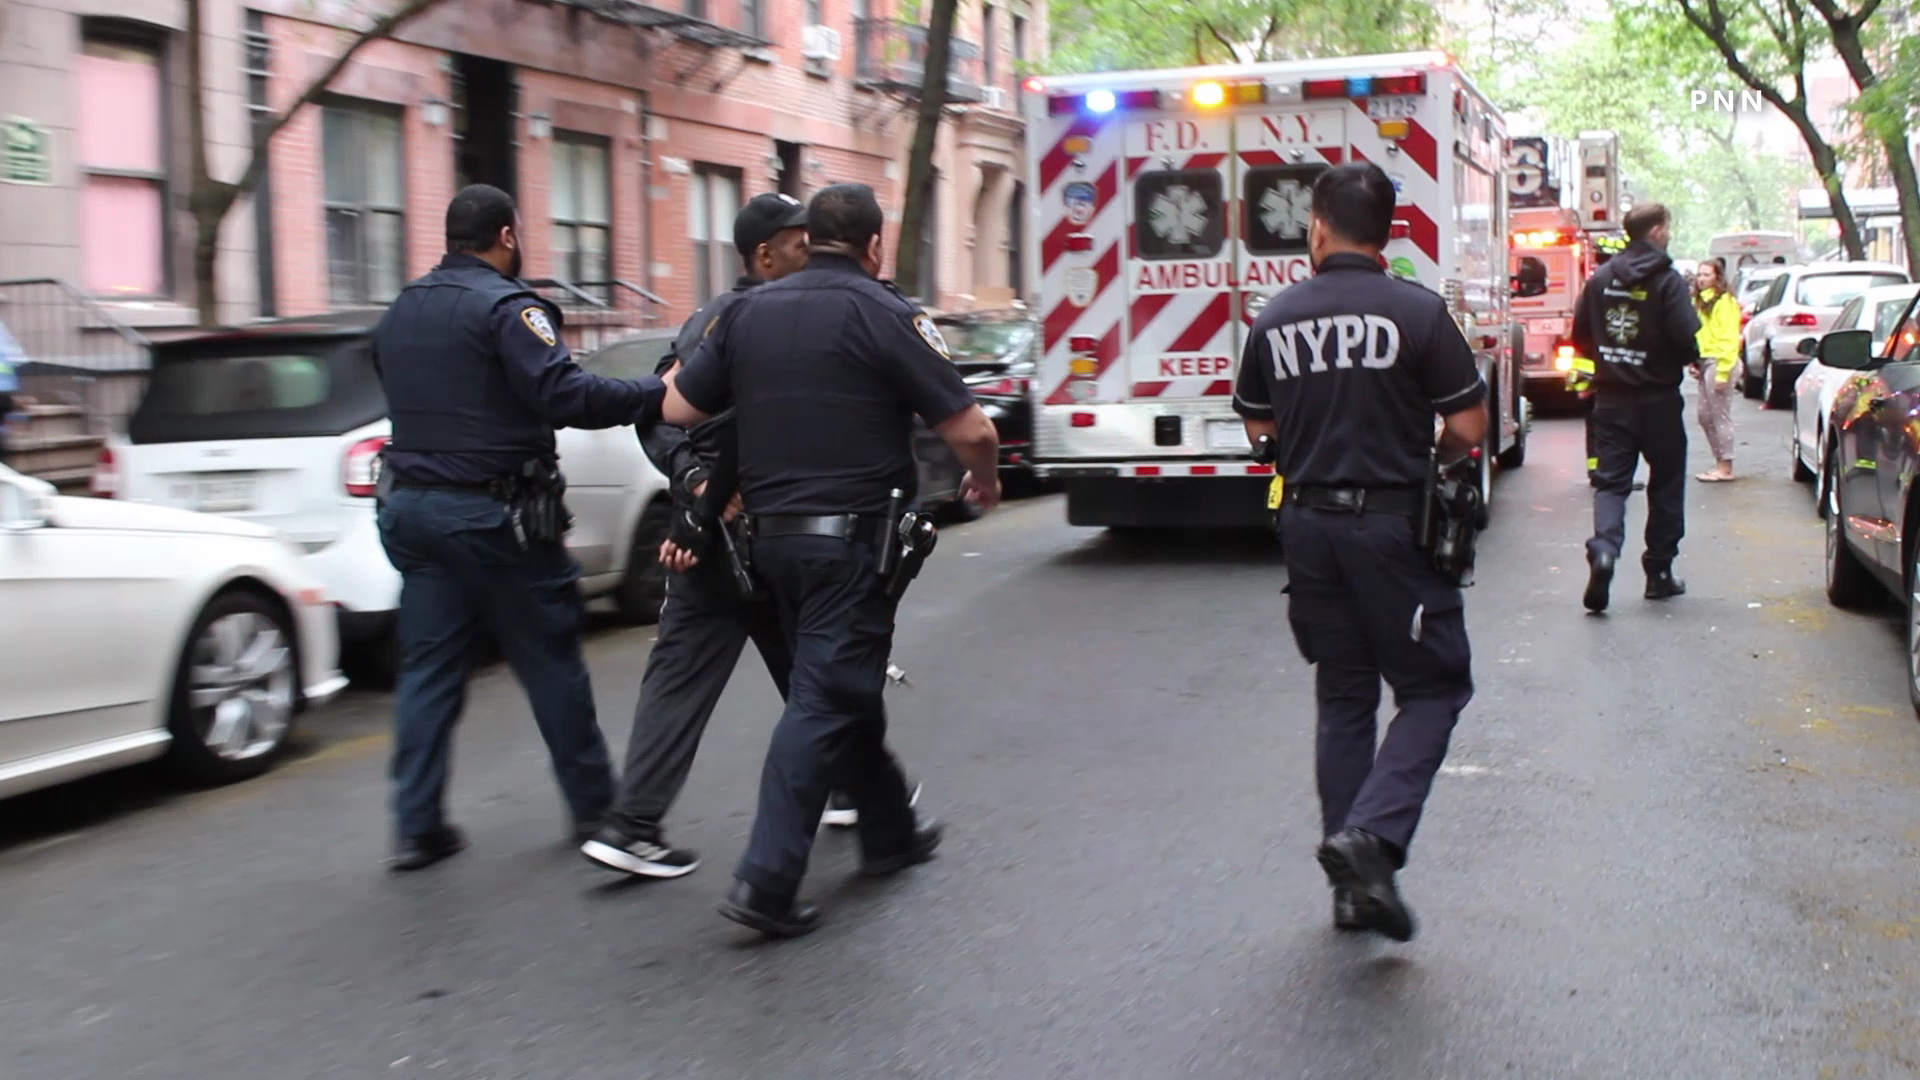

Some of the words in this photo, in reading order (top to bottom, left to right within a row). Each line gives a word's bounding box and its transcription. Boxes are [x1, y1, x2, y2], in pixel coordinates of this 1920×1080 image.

[1368, 97, 1417, 117] 2125
[1145, 119, 1209, 151] F.D.
[1260, 113, 1324, 147] N.Y.
[1136, 257, 1317, 290] AMBULANC
[1265, 313, 1401, 381] NYPD
[1159, 356, 1232, 376] KEEP
